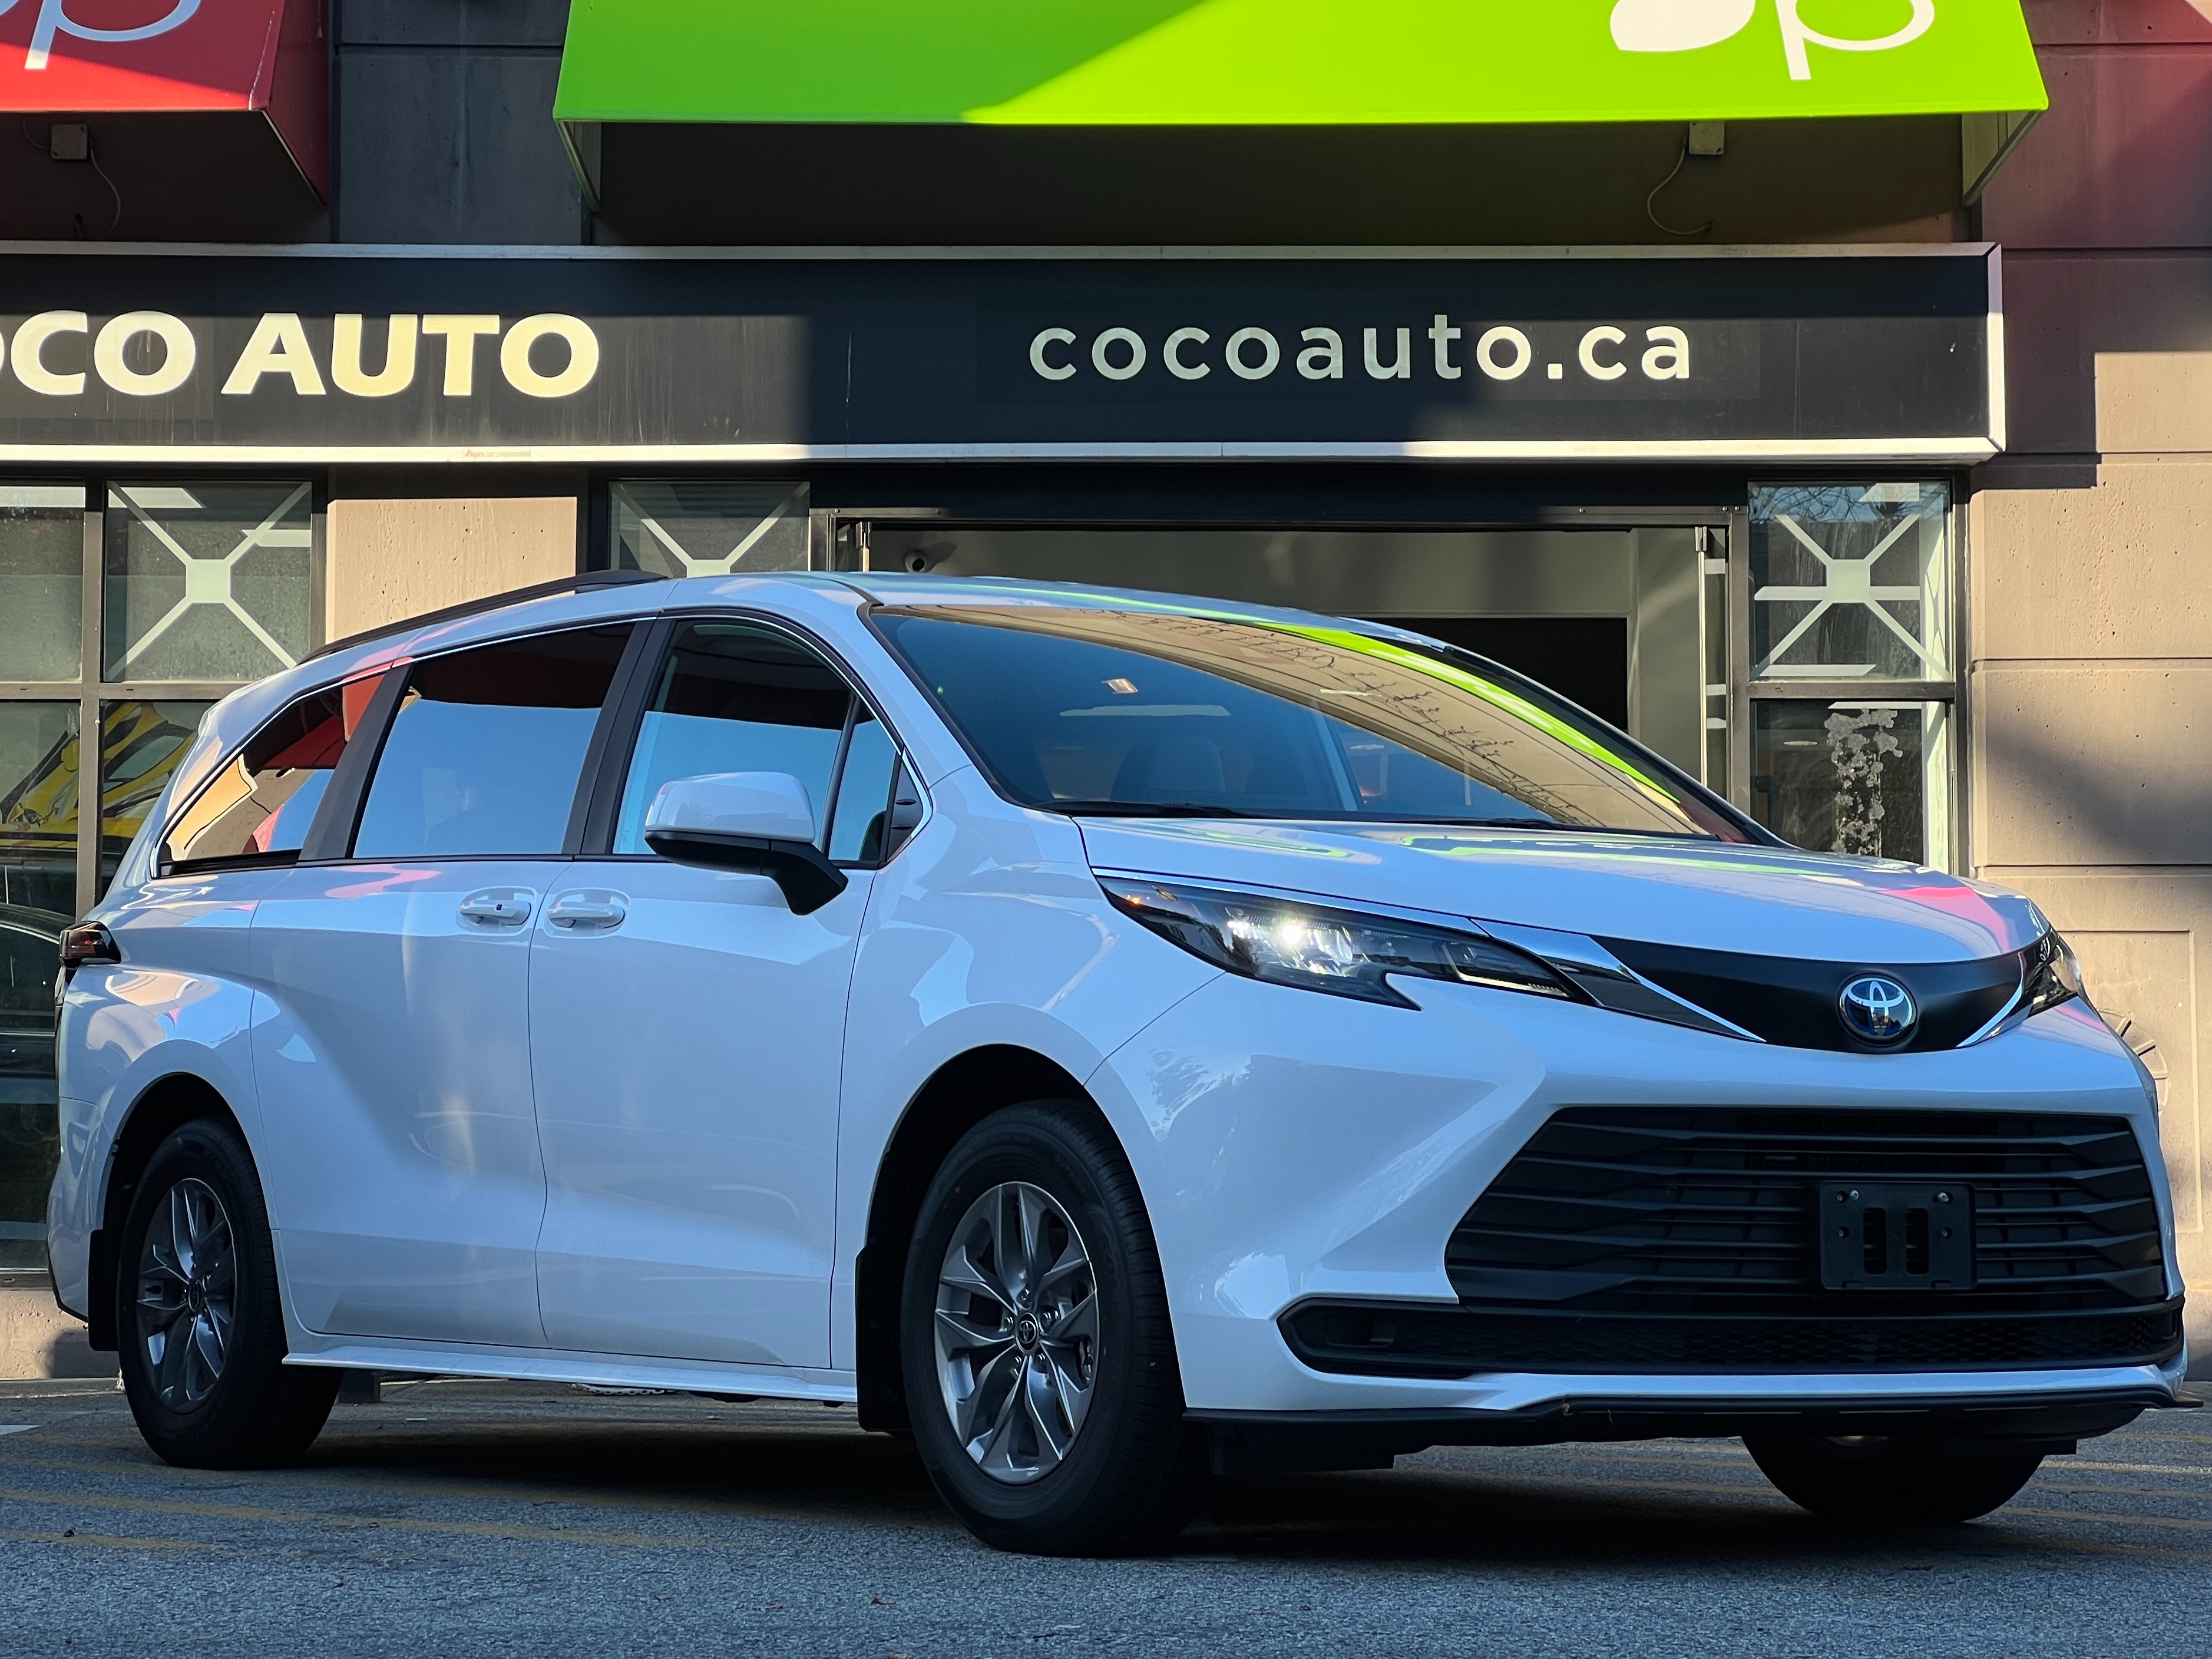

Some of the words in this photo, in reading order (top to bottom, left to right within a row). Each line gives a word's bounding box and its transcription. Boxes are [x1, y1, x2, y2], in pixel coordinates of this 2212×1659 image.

[0, 310, 197, 397] CO
[220, 313, 600, 399] AUTO
[1029, 315, 1689, 381] cocoauto.ca
